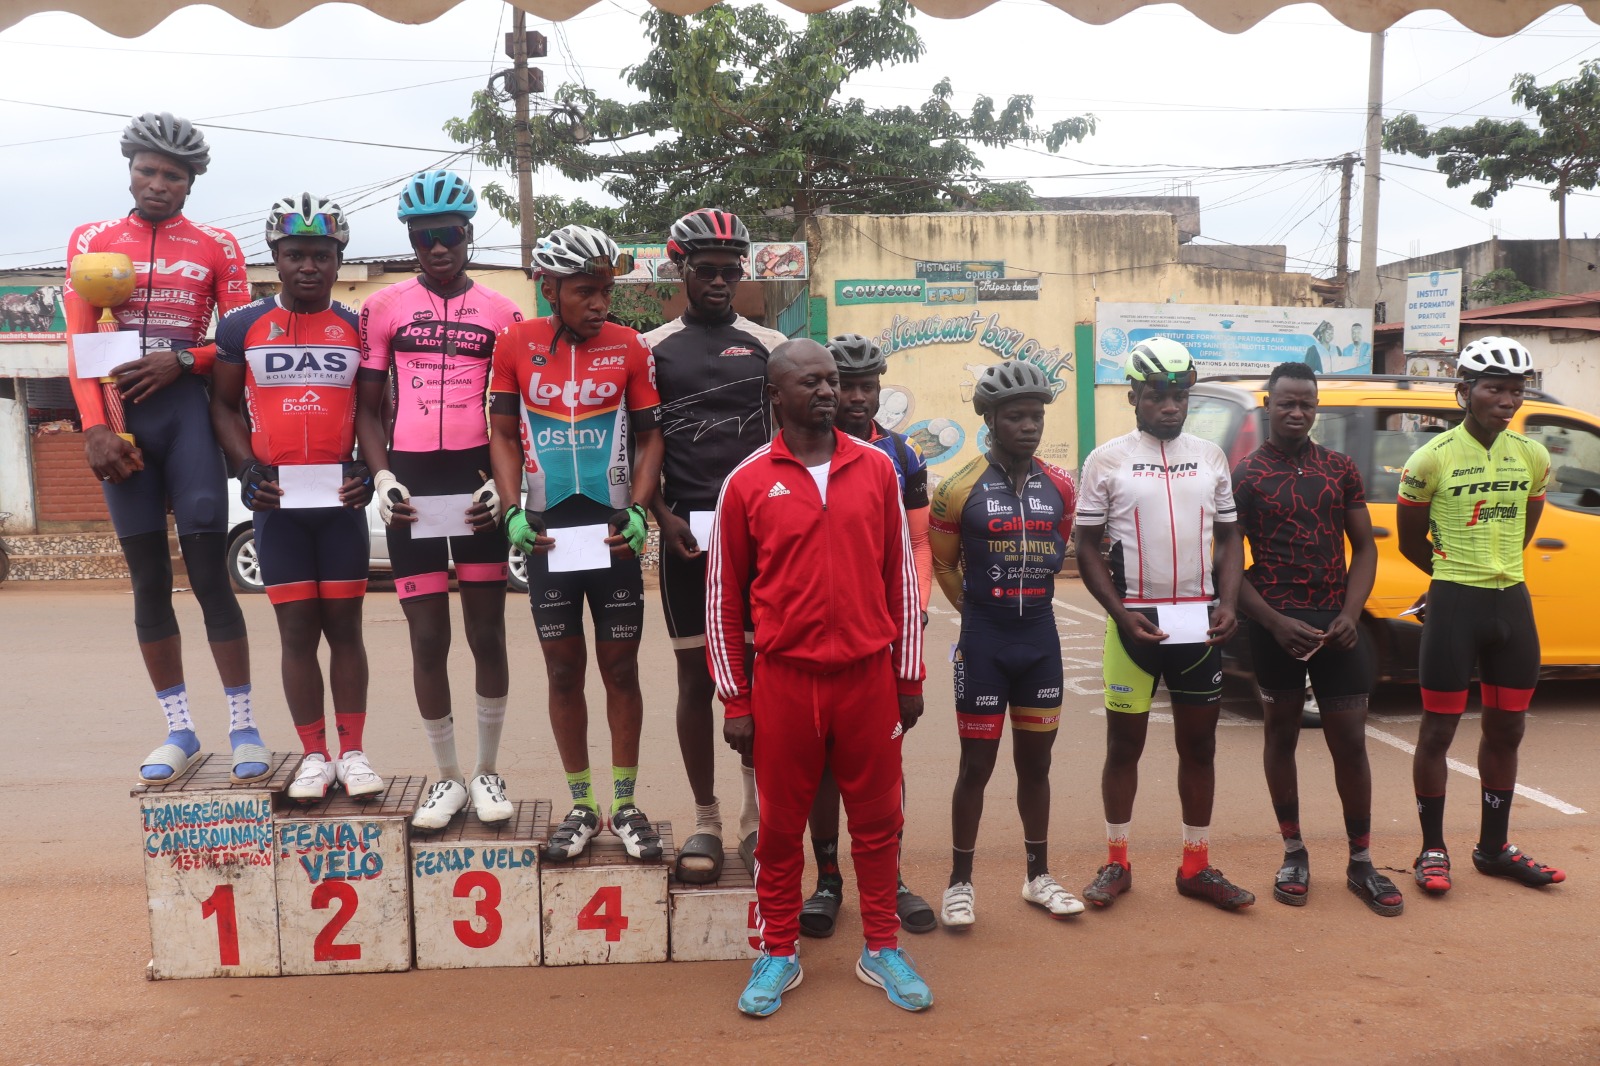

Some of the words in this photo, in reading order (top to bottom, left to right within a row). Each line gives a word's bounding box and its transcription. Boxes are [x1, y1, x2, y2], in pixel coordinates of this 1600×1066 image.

[637, 247, 661, 259] BON
[965, 270, 999, 279] GOMBO
[842, 285, 923, 299] COUSCOUS
[928, 287, 966, 302] ERU
[1416, 289, 1448, 298] INSTITUT
[1419, 300, 1455, 308] FORMATION
[1418, 312, 1446, 320] PRATIQUE
[402, 325, 431, 337] Jos
[435, 325, 487, 344] Feron
[872, 310, 986, 357] estaurant
[979, 312, 1025, 357] bon
[1154, 332, 1185, 340] INSTITUT
[415, 338, 442, 347] LADY
[265, 352, 348, 373] DAS
[592, 356, 626, 367] CAPS
[528, 372, 618, 408] lotto
[283, 403, 321, 412] Doorn
[537, 428, 607, 449] dstny
[617, 415, 626, 462] SOLAR
[1433, 437, 1454, 451] TREK
[1451, 466, 1485, 477] Santini
[768, 489, 790, 498] adidas
[1448, 481, 1530, 496] TREK
[1466, 500, 1518, 526] Segafredo
[988, 541, 1016, 552] TOPS
[1020, 541, 1057, 554] ANTIEK
[539, 623, 565, 631] viking
[957, 662, 965, 699] DEVOS
[147, 824, 273, 857] CAMEROUNAISE
[280, 823, 383, 856] FENAP
[300, 852, 384, 884] VELO
[415, 847, 475, 878] FENAP
[482, 847, 535, 870] VELO
[452, 871, 502, 948] 3
[577, 885, 628, 942] 4
[201, 884, 240, 965] 1
[311, 881, 361, 961] 2
